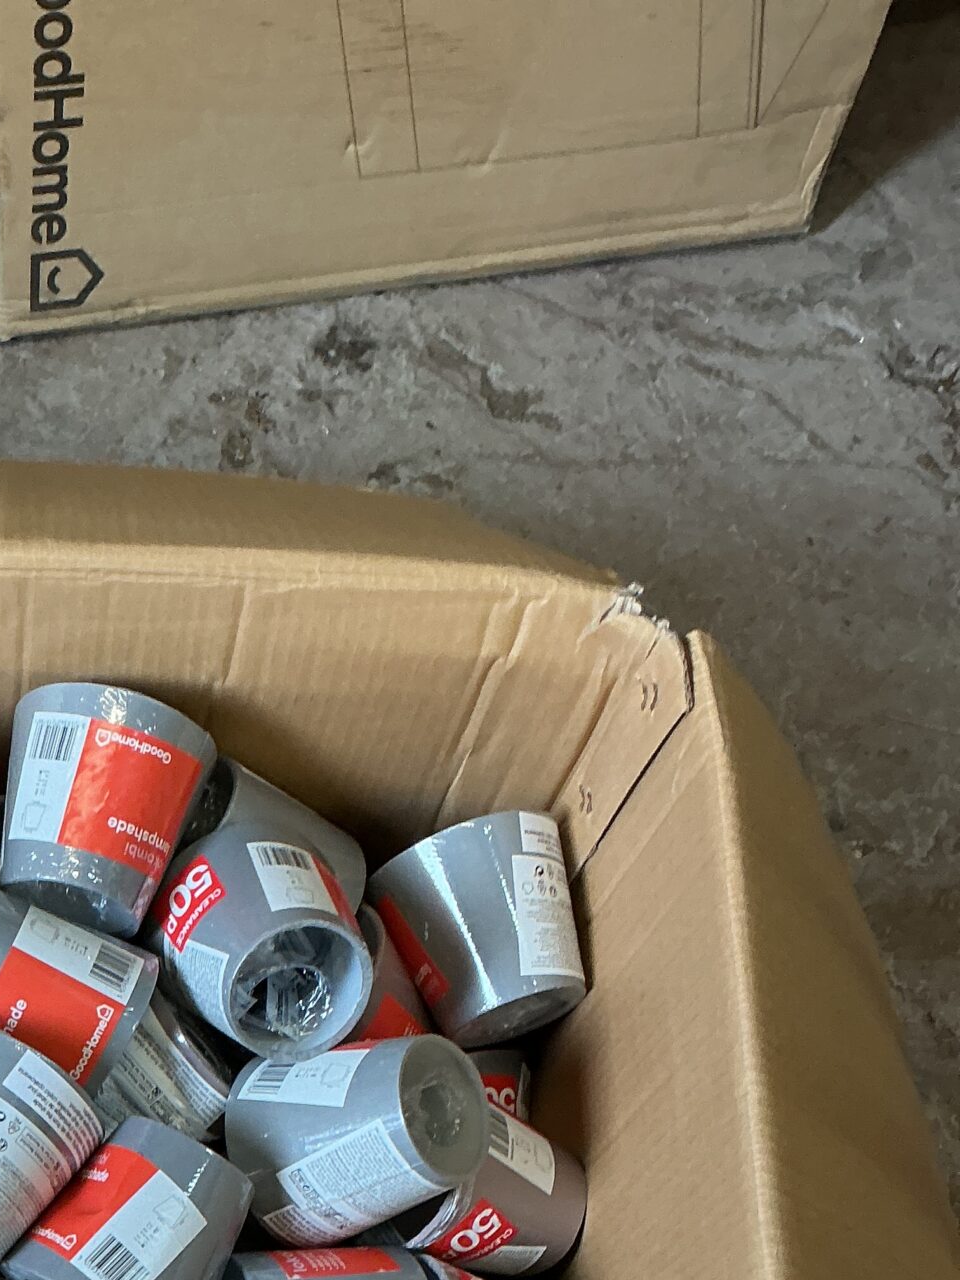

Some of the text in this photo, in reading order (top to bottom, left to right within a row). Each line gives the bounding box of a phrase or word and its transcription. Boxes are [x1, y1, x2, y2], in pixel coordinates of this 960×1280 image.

[31, 0, 84, 244] odHome
[112, 733, 172, 765] GoodHome
[176, 886, 223, 947] CLEARANCE
[68, 1019, 110, 1081] GoodHome
